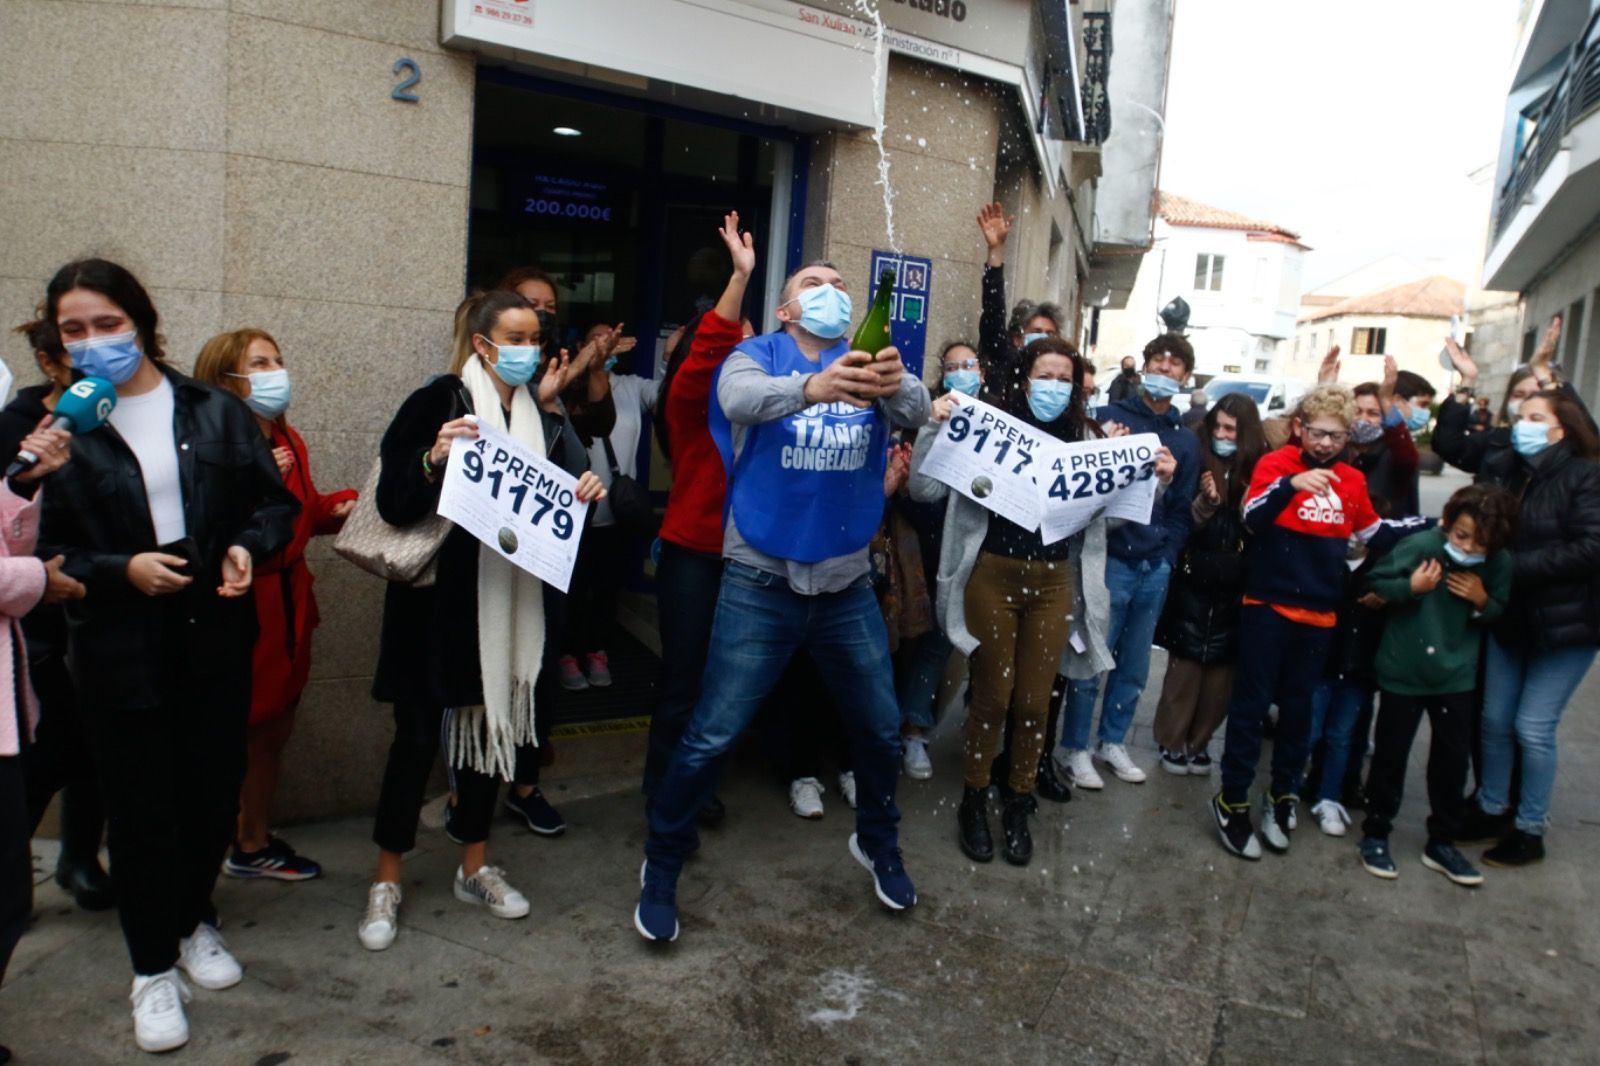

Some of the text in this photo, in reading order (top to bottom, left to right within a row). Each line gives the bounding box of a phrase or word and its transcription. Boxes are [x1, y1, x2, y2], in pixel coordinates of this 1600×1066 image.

[894, 0, 967, 22] ado
[799, 8, 819, 25] San
[955, 52, 961, 65] 1
[392, 58, 421, 103] 2
[525, 198, 611, 221] 200.000€
[791, 416, 873, 449] 17 AÑOS
[947, 415, 1037, 485] 9117
[980, 413, 1041, 451] PREM
[1071, 445, 1151, 470] PREMIO
[462, 450, 574, 540] 91179
[491, 448, 573, 508] PREMIO
[1297, 507, 1344, 524] adidas
